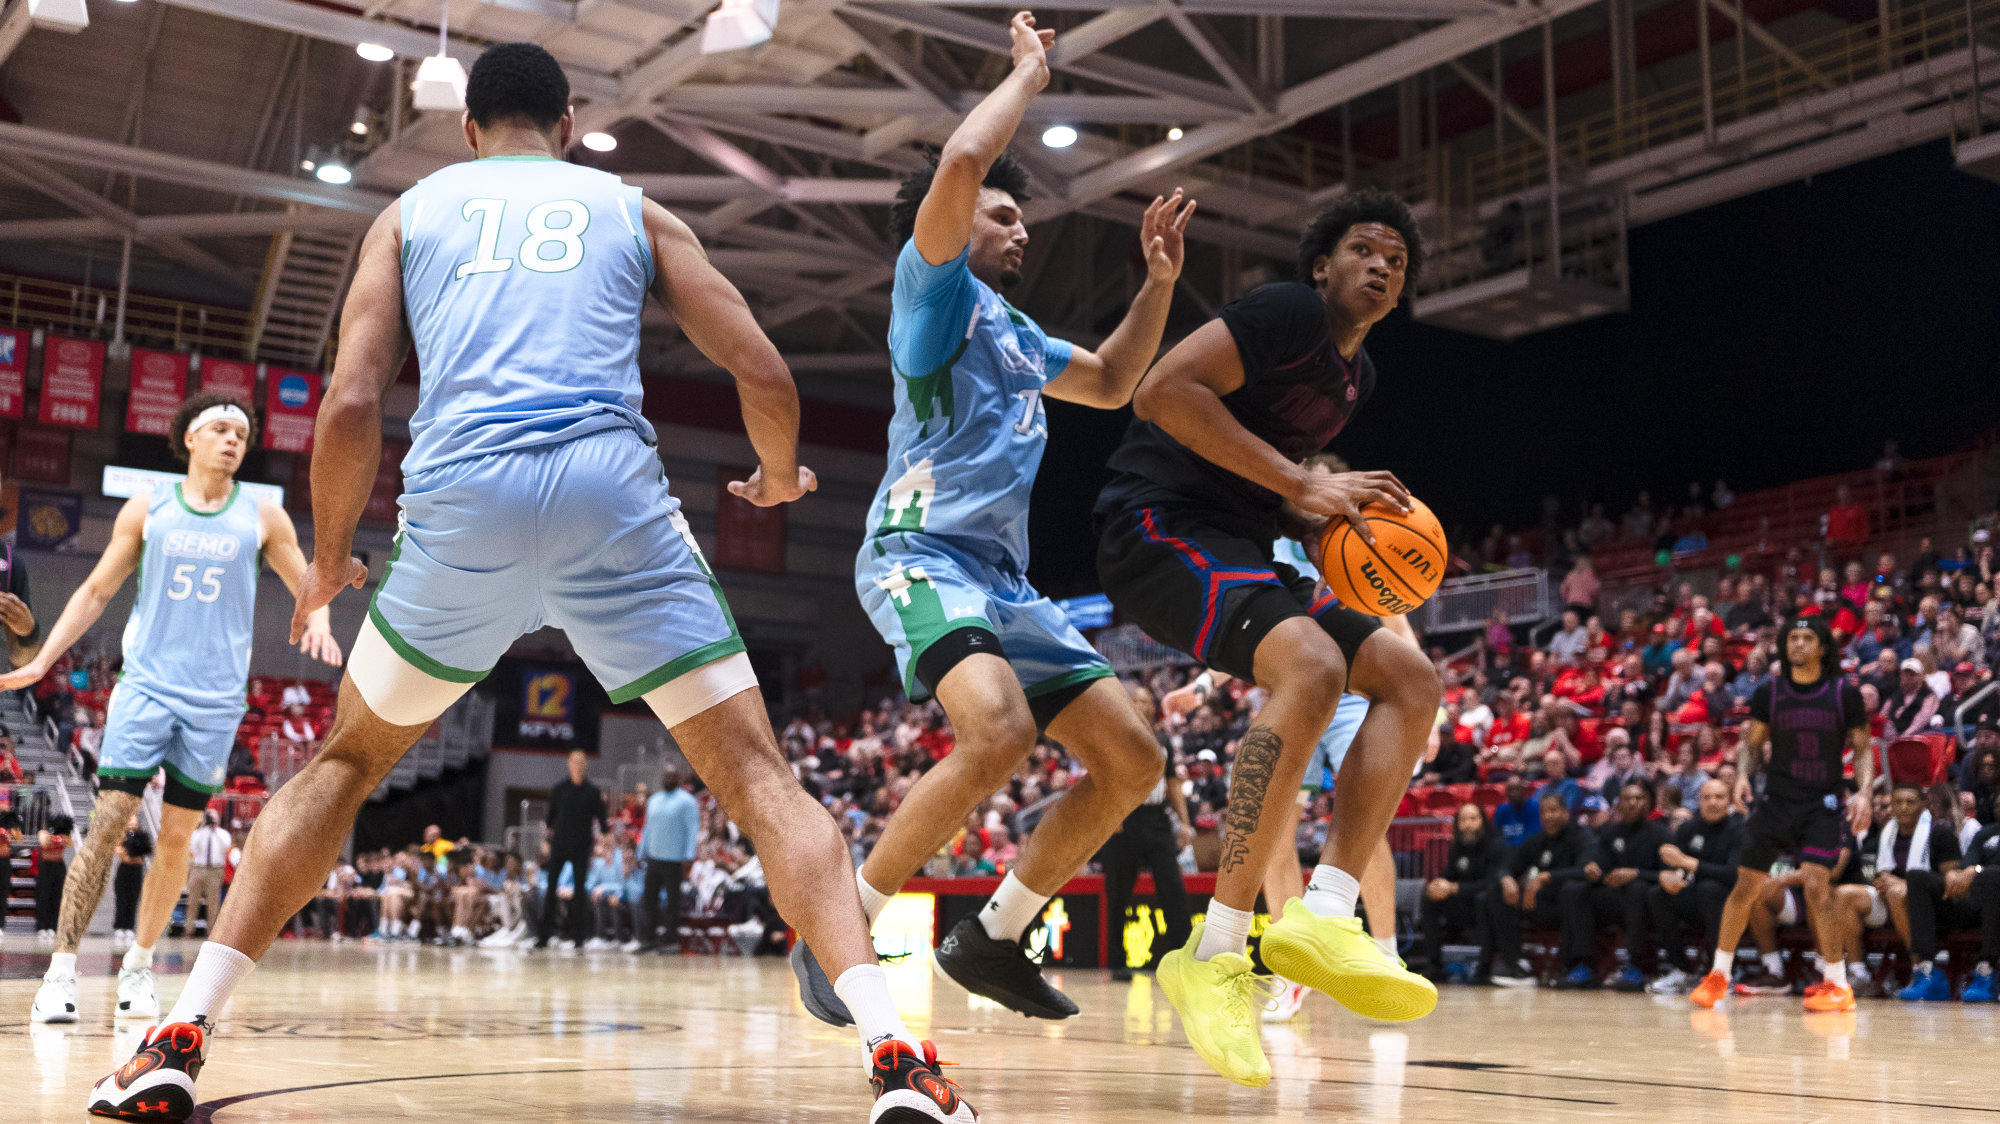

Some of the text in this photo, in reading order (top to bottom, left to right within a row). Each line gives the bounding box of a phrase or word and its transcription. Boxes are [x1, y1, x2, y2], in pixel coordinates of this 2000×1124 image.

[454, 197, 592, 282] 18
[163, 530, 238, 560] SEMO
[166, 563, 226, 604] 55
[1360, 559, 1416, 614] Wilson
[526, 673, 571, 717] 12
[518, 720, 575, 741] KFVS
